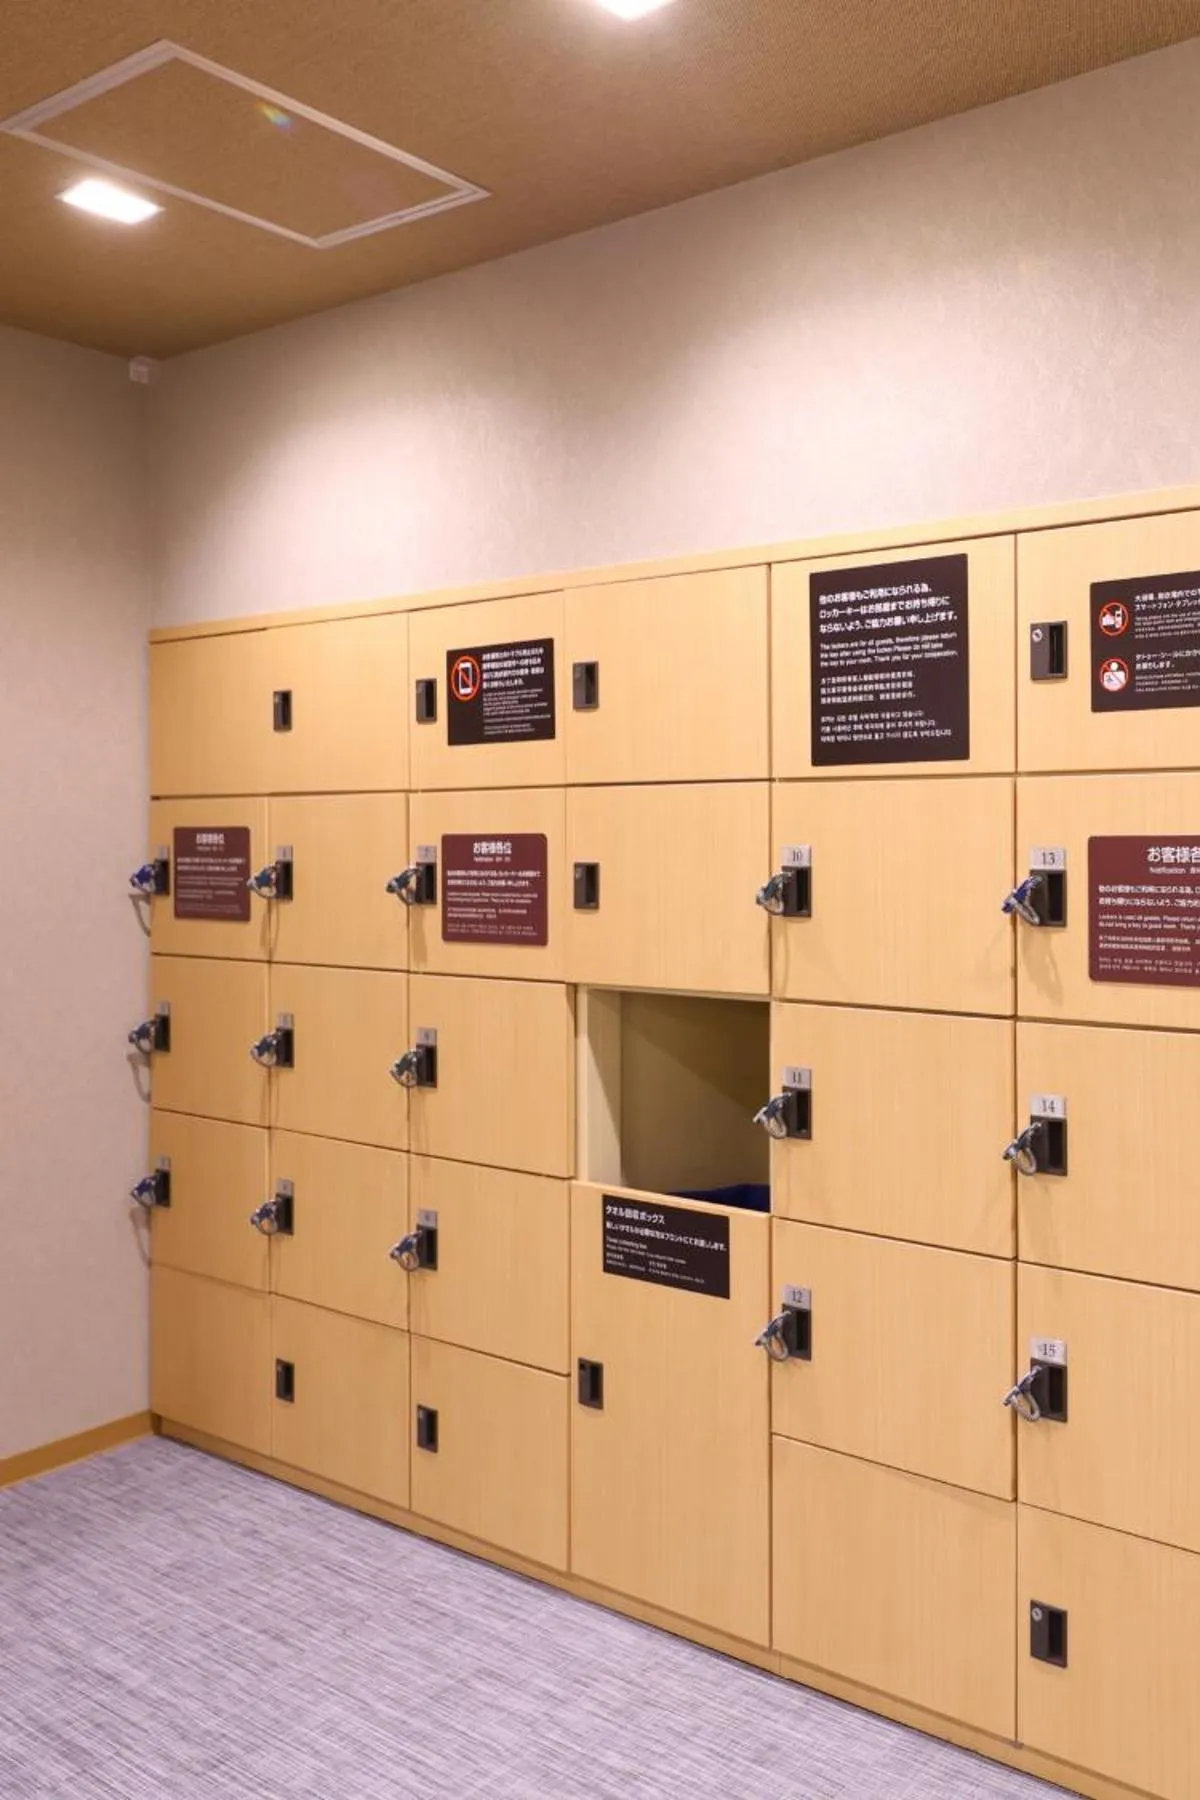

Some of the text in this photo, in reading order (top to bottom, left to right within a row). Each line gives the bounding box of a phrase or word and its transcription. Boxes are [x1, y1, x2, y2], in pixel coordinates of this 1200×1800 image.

[791, 850, 802, 861] 10
[1042, 851, 1055, 864] 13
[1041, 1099, 1055, 1112] 14
[791, 1290, 802, 1303] 12
[1042, 1343, 1055, 1356] 15
